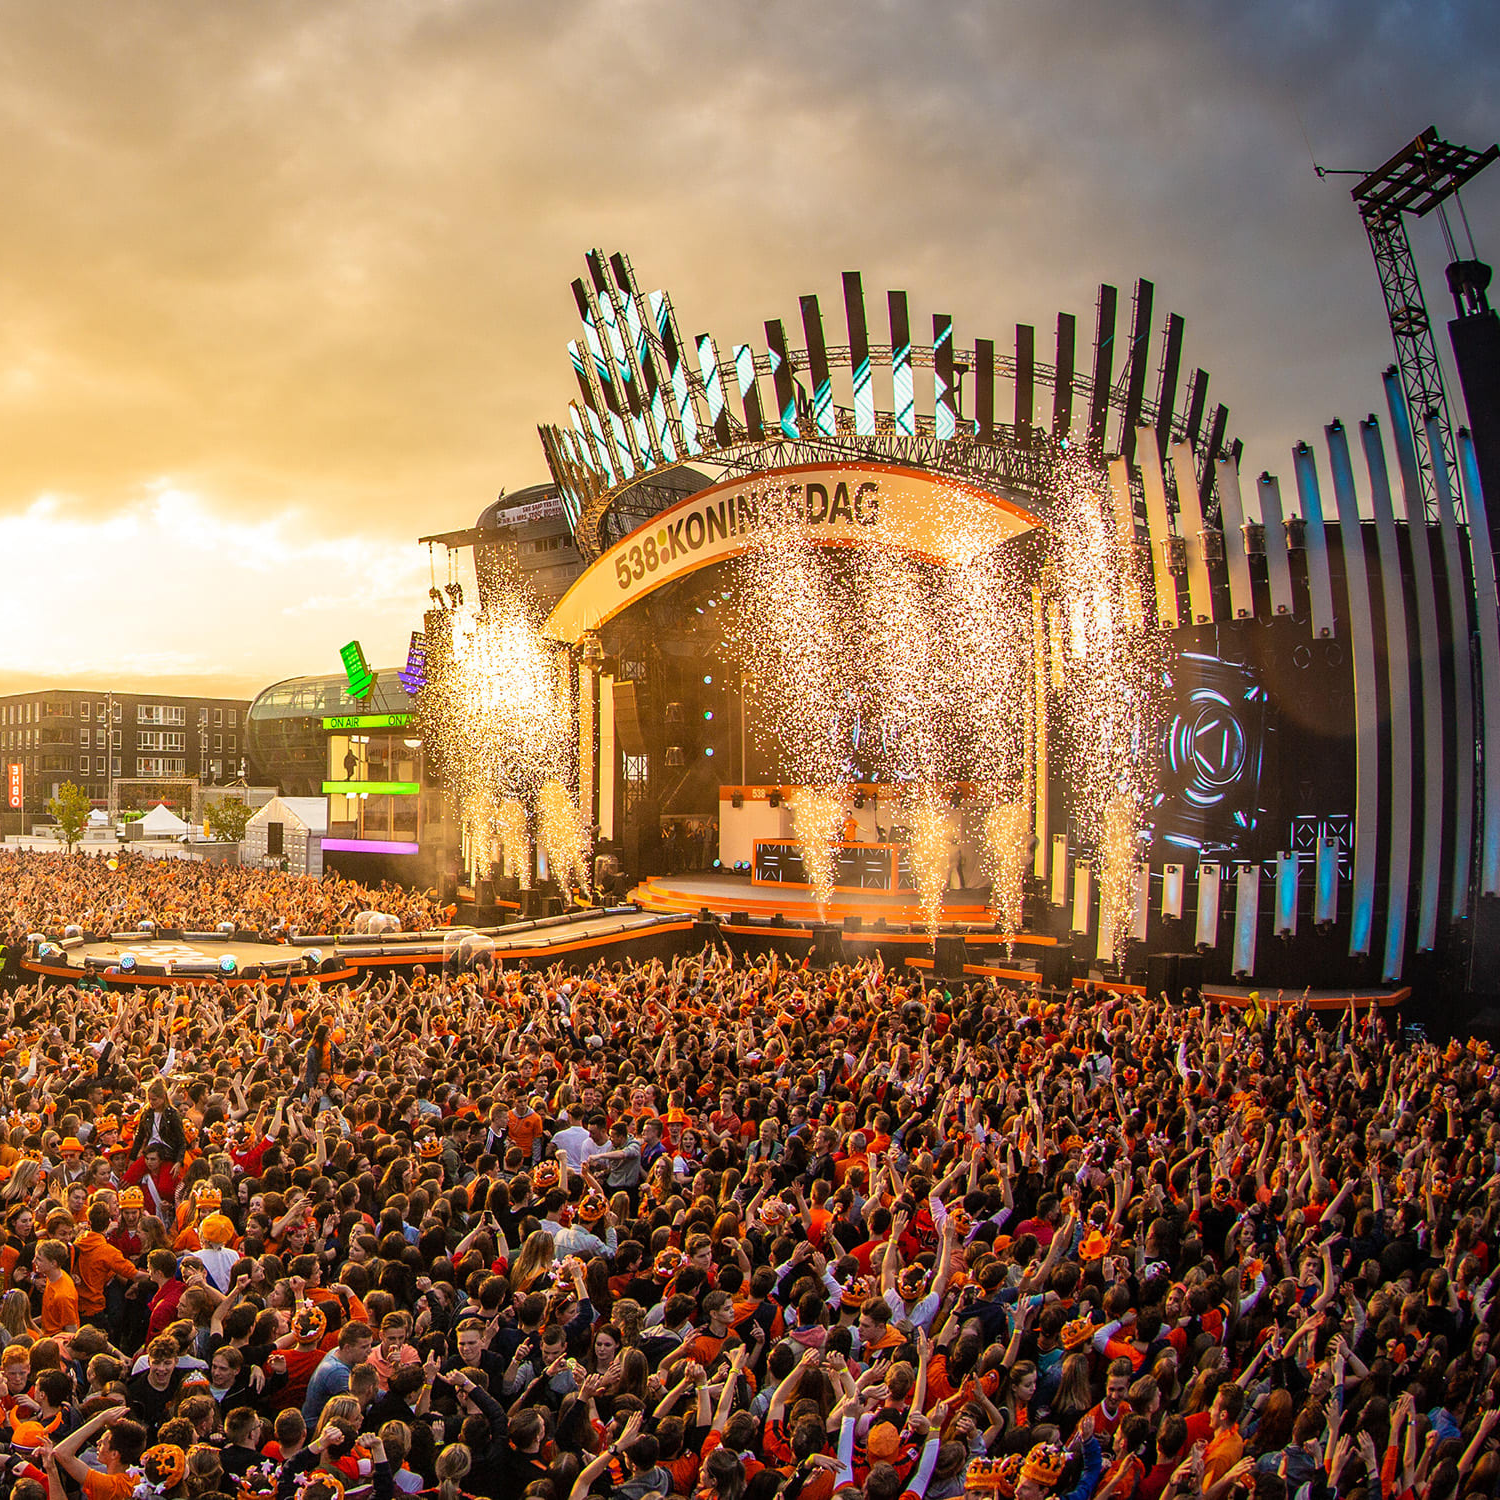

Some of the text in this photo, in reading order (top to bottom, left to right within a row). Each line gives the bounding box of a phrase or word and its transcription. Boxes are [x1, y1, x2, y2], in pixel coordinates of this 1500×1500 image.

[330, 717, 360, 728] ON AIR
[388, 715, 402, 726] ON
